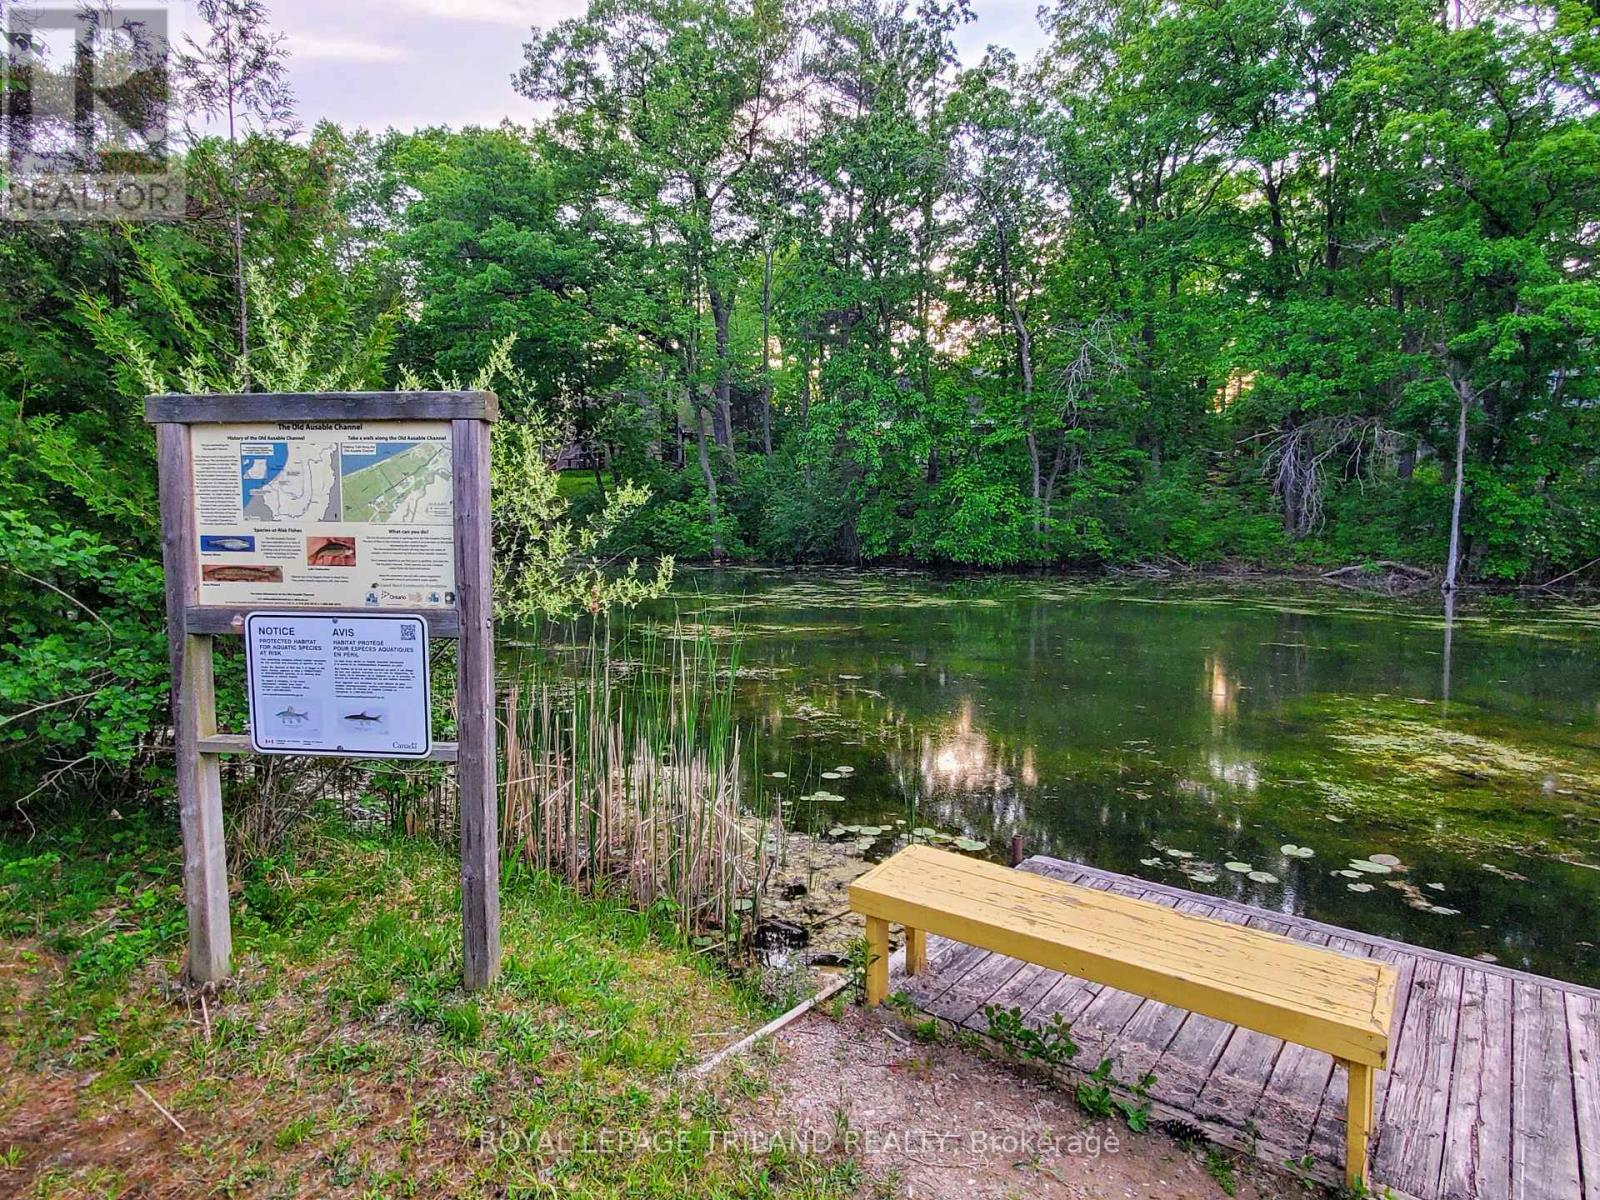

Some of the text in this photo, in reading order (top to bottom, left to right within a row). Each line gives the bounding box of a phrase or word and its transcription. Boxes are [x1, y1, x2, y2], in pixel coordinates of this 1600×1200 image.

[258, 627, 295, 635] NOTICE
[332, 628, 354, 636] AVIS
[392, 741, 418, 749] Canada
